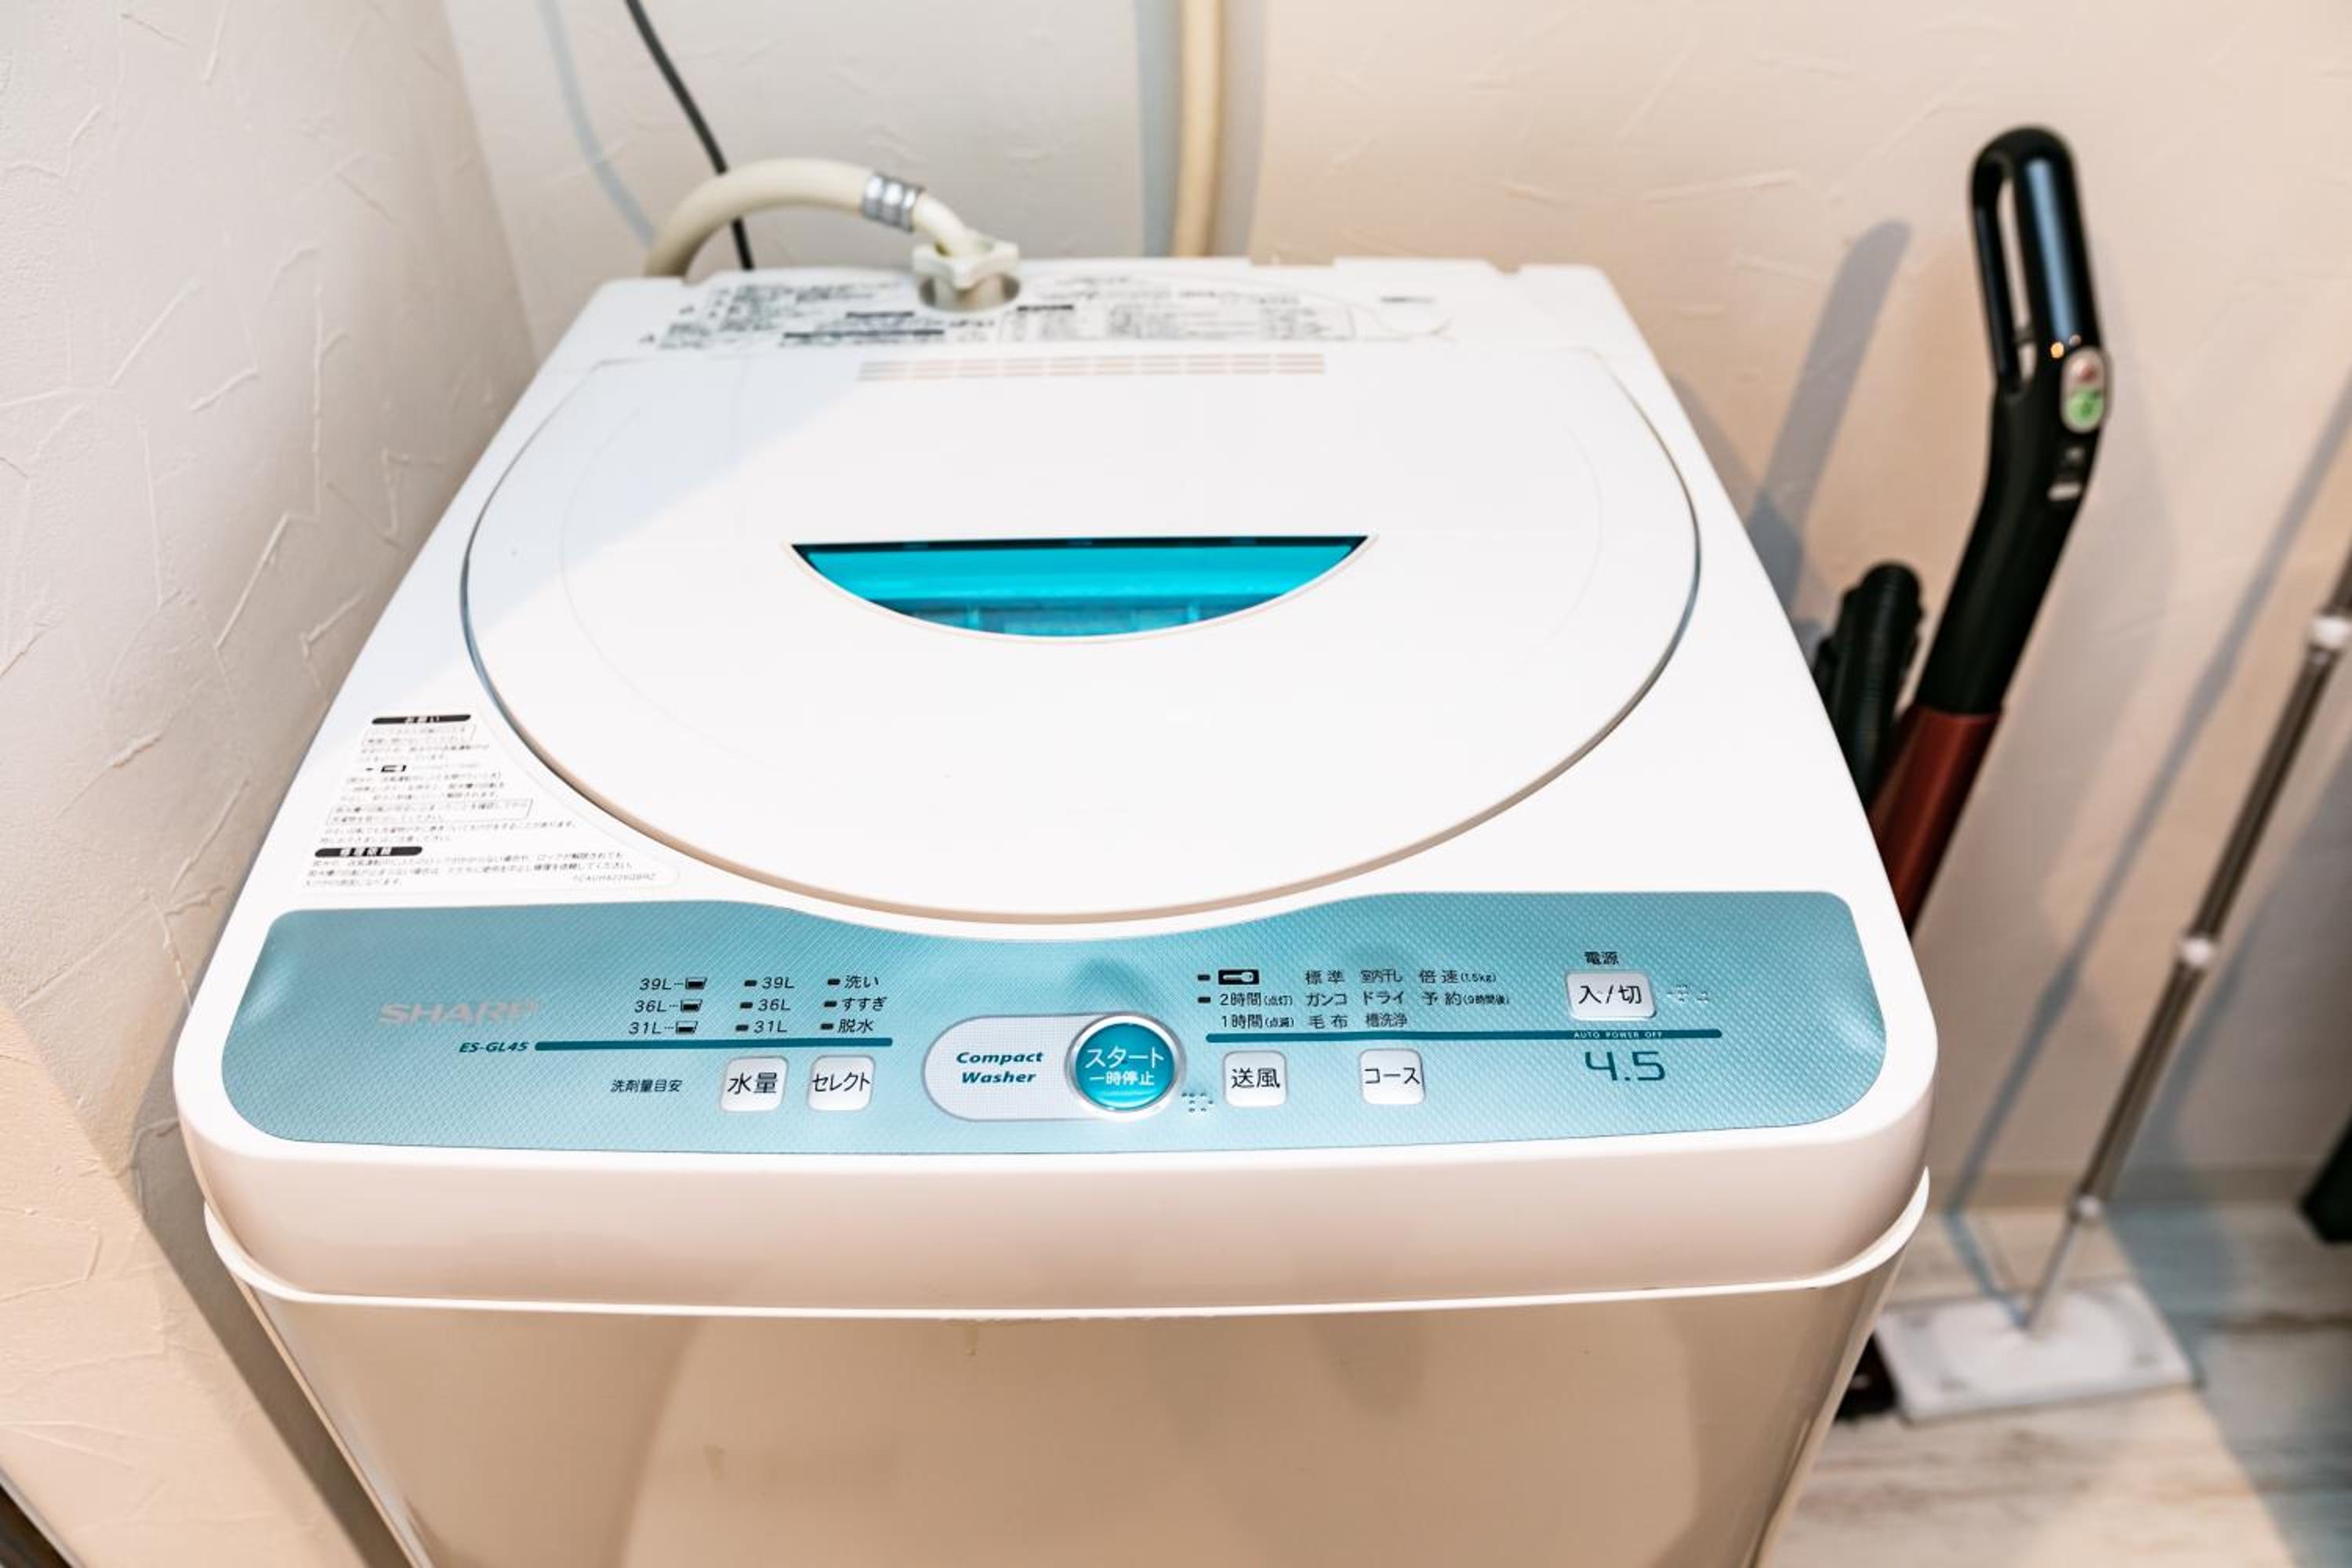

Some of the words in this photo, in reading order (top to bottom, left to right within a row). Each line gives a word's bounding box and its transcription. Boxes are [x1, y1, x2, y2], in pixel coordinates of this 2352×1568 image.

[1584, 951, 1619, 965] 電源
[639, 978, 672, 990] 39L
[761, 977, 795, 989] 39L
[844, 975, 880, 989] 洗い
[1305, 993, 1348, 1006] ガンコ
[1363, 991, 1404, 1005] ドライ
[1578, 985, 1642, 1004] 入/切
[634, 1001, 667, 1013] 36L
[757, 999, 791, 1011] 36L
[841, 996, 886, 1011] すすぎ
[377, 1000, 538, 1029] SHARP
[1309, 1014, 1348, 1029] 毛布
[628, 1022, 662, 1035] 31L
[753, 1020, 788, 1033] 31L
[837, 1019, 874, 1033] 脱水
[459, 1042, 529, 1053] ES-GL45
[956, 1051, 1044, 1065] Compact
[1084, 1046, 1165, 1069] スタート
[1584, 1051, 1666, 1081] 4.5
[811, 1072, 872, 1093] セレクト
[962, 1072, 1036, 1083] Washer
[1089, 1070, 1155, 1086] 一時停止
[1231, 1067, 1281, 1089] 送風
[1364, 1067, 1421, 1084] コース
[610, 1079, 683, 1093] 洗剤量目安
[728, 1072, 779, 1094] 水量
